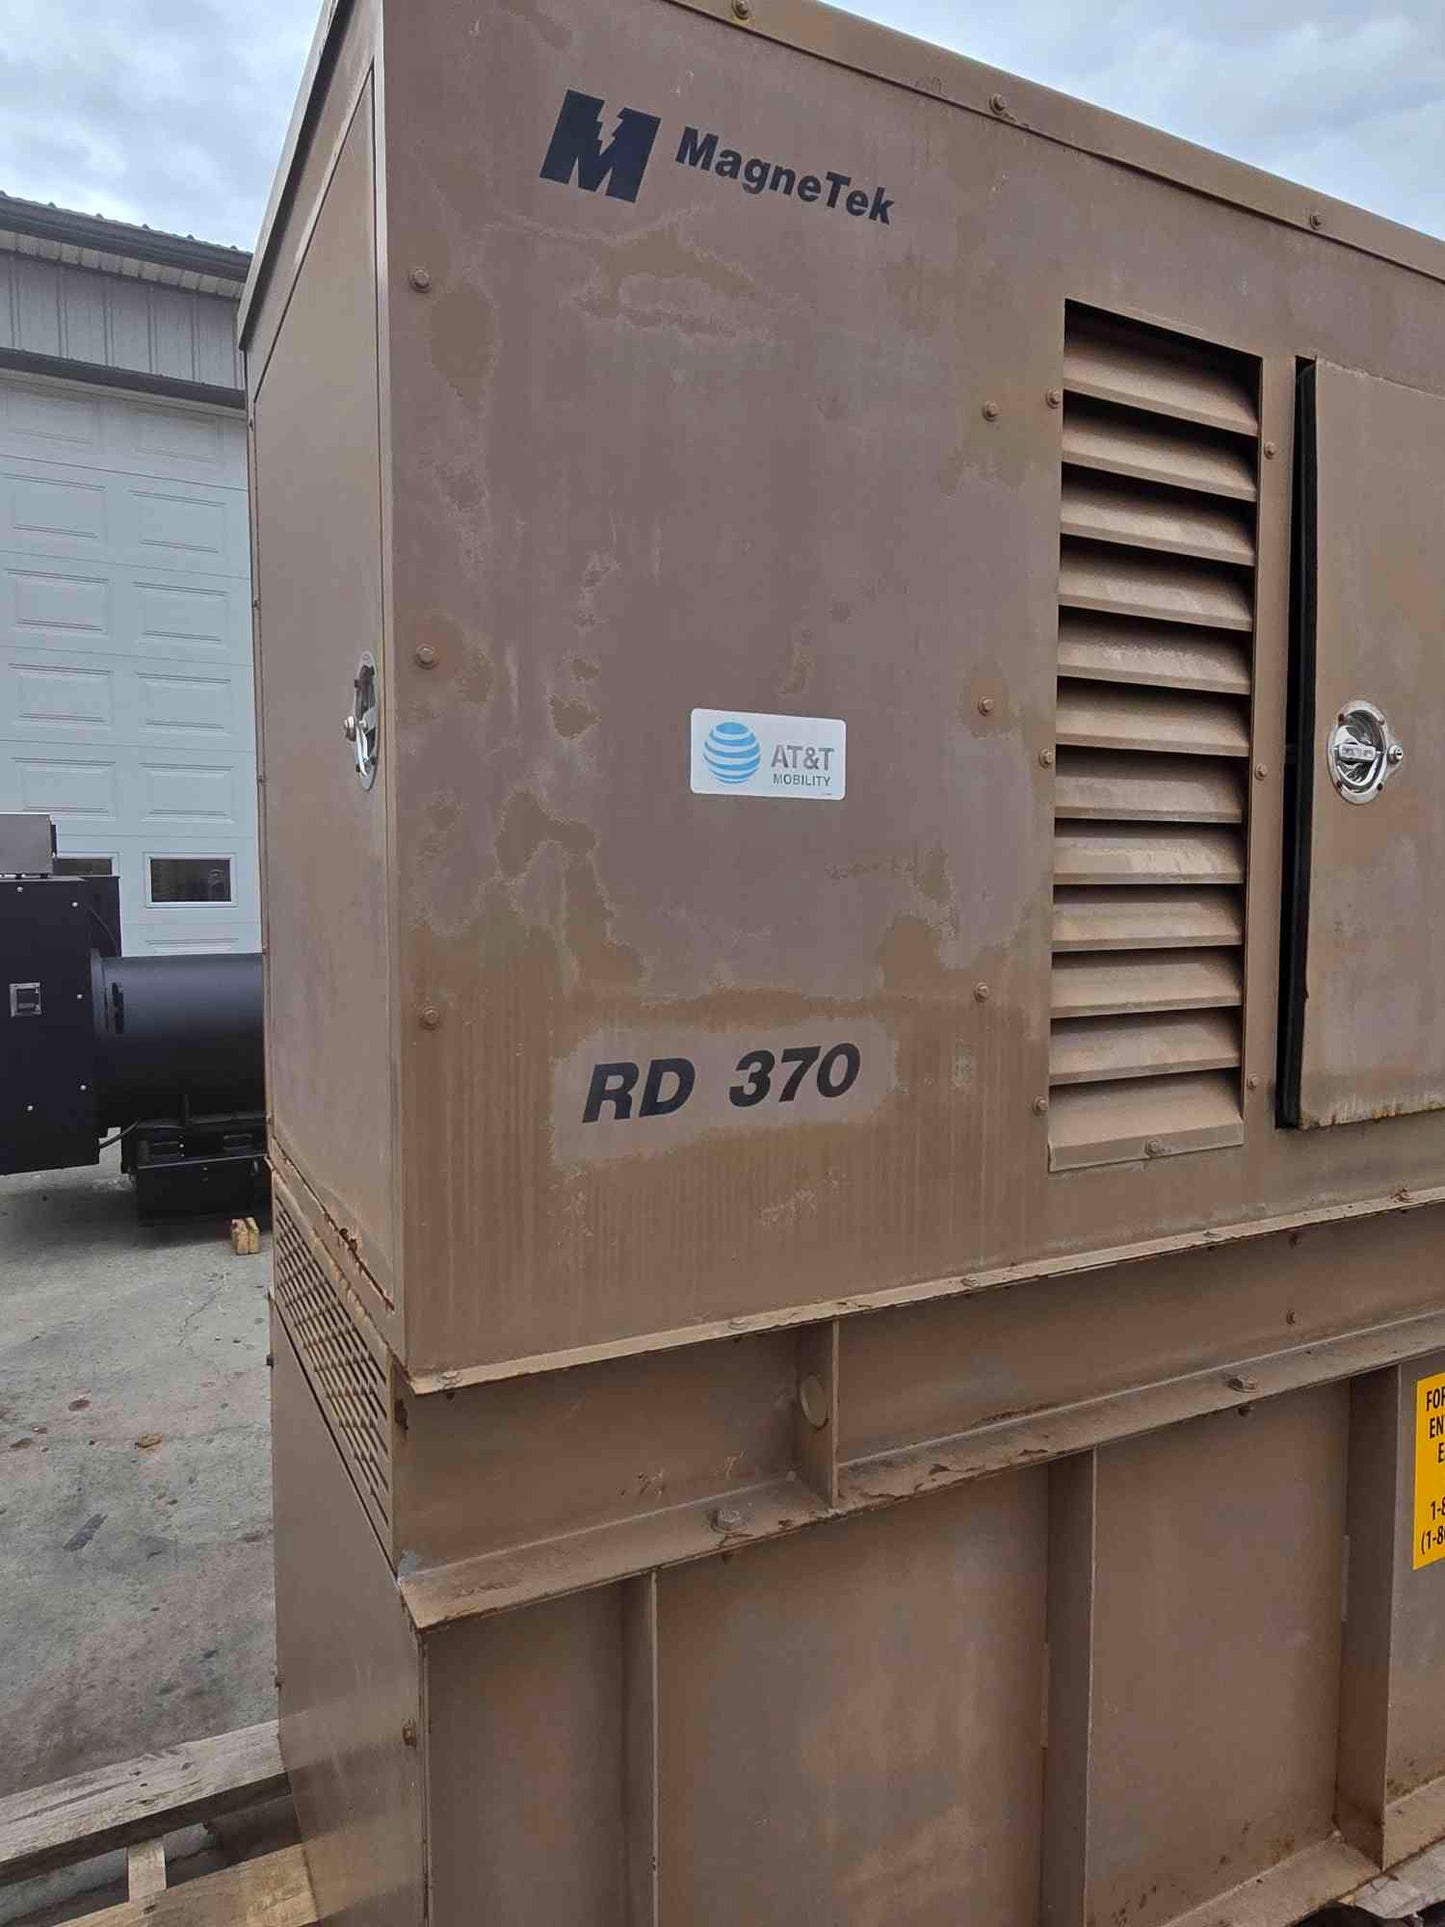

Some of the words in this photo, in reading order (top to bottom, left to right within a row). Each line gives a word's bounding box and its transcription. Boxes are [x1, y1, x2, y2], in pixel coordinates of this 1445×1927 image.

[675, 126, 895, 225] MagneTek
[770, 744, 835, 771] AT&T
[773, 773, 831, 787] MOBILITY
[582, 1057, 696, 1123] RD
[729, 1042, 861, 1108] 370
